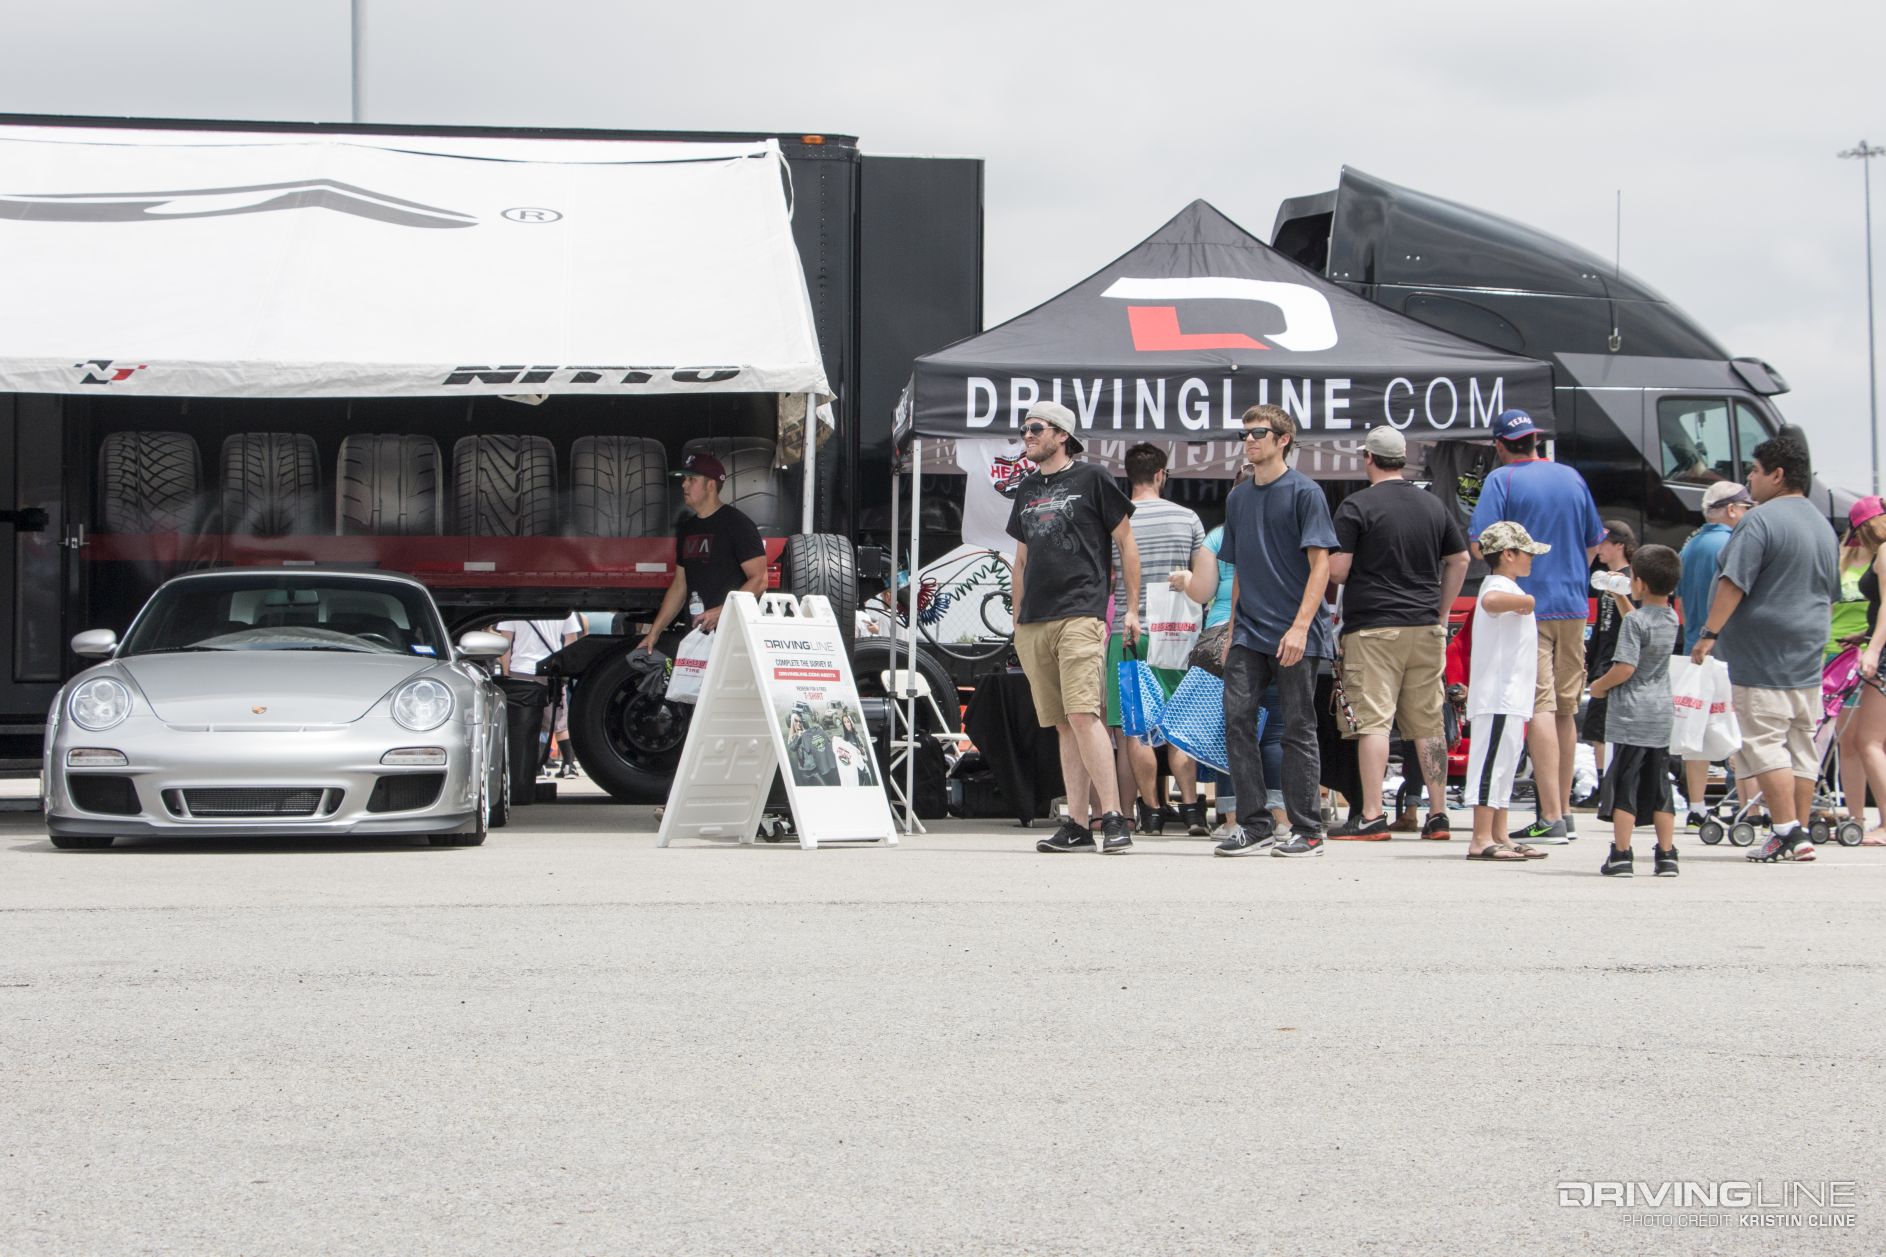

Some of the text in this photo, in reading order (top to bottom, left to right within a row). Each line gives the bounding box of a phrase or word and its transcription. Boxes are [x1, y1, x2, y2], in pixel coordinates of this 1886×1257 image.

[442, 365, 741, 385] NITTO
[764, 640, 836, 652] DRIVINGLINE
[775, 658, 800, 667] COMPLETE
[800, 660, 809, 668] THE
